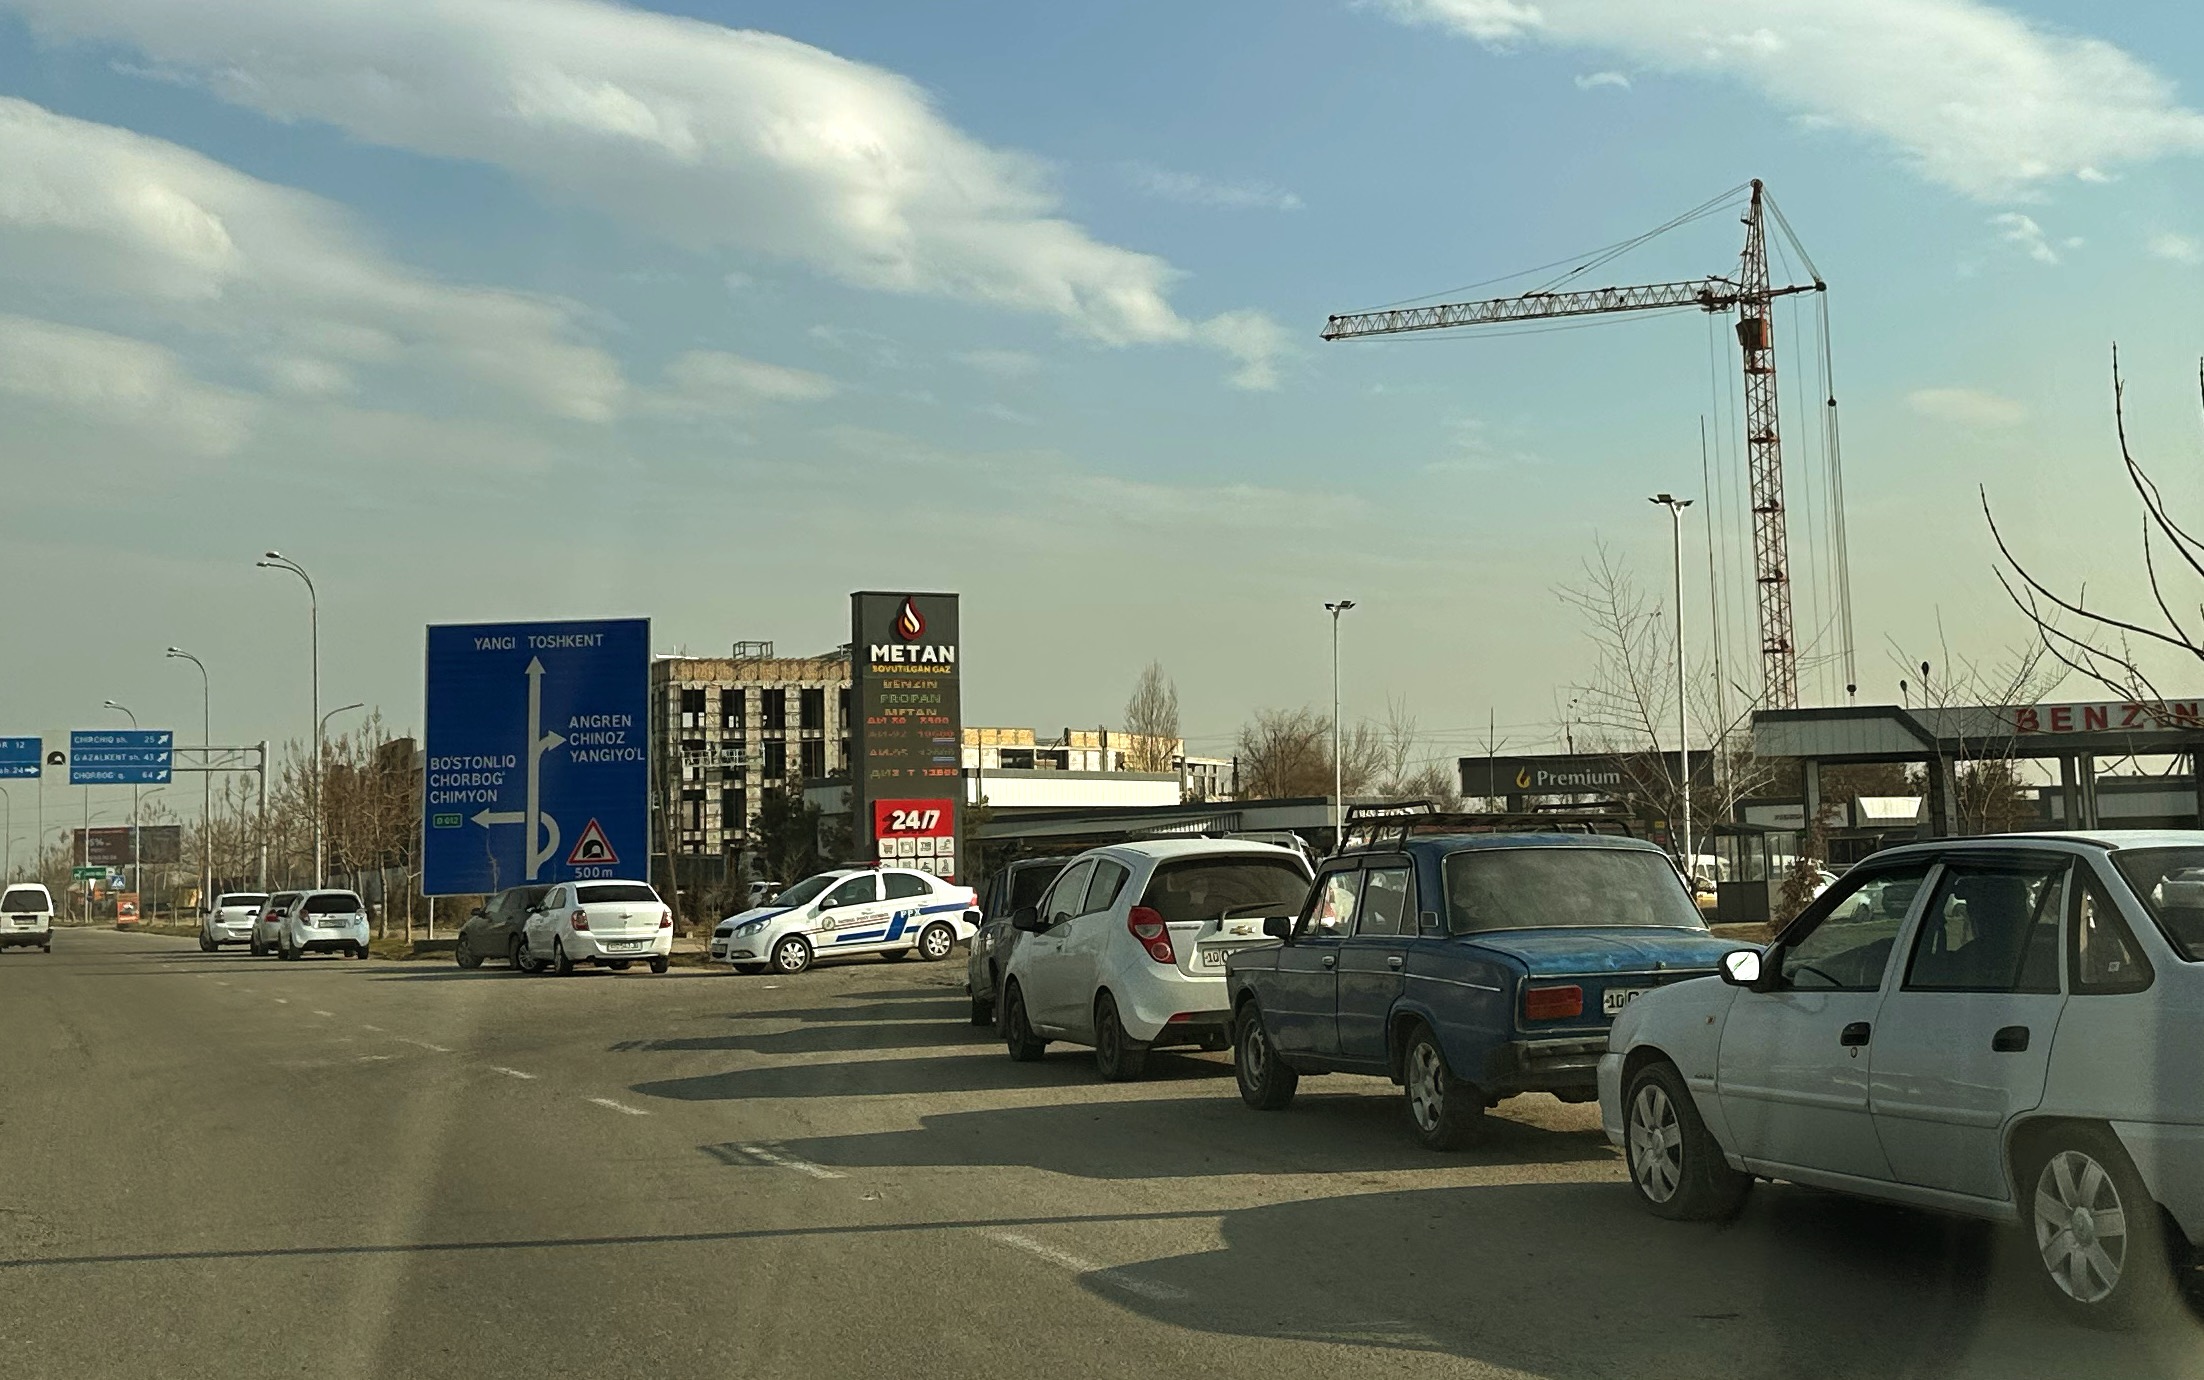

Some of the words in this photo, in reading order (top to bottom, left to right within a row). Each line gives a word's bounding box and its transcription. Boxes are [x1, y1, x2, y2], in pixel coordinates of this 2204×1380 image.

[474, 637, 516, 650] YANGI
[528, 634, 604, 649] TOSHKENT
[871, 644, 955, 663] METAN
[568, 714, 632, 729] ANGREN
[569, 731, 625, 746] CHINOZ
[1537, 768, 1620, 786] Premium
[430, 789, 498, 804] CHIMYON
[891, 809, 941, 831] 24/7
[1608, 993, 1625, 1009] 10
